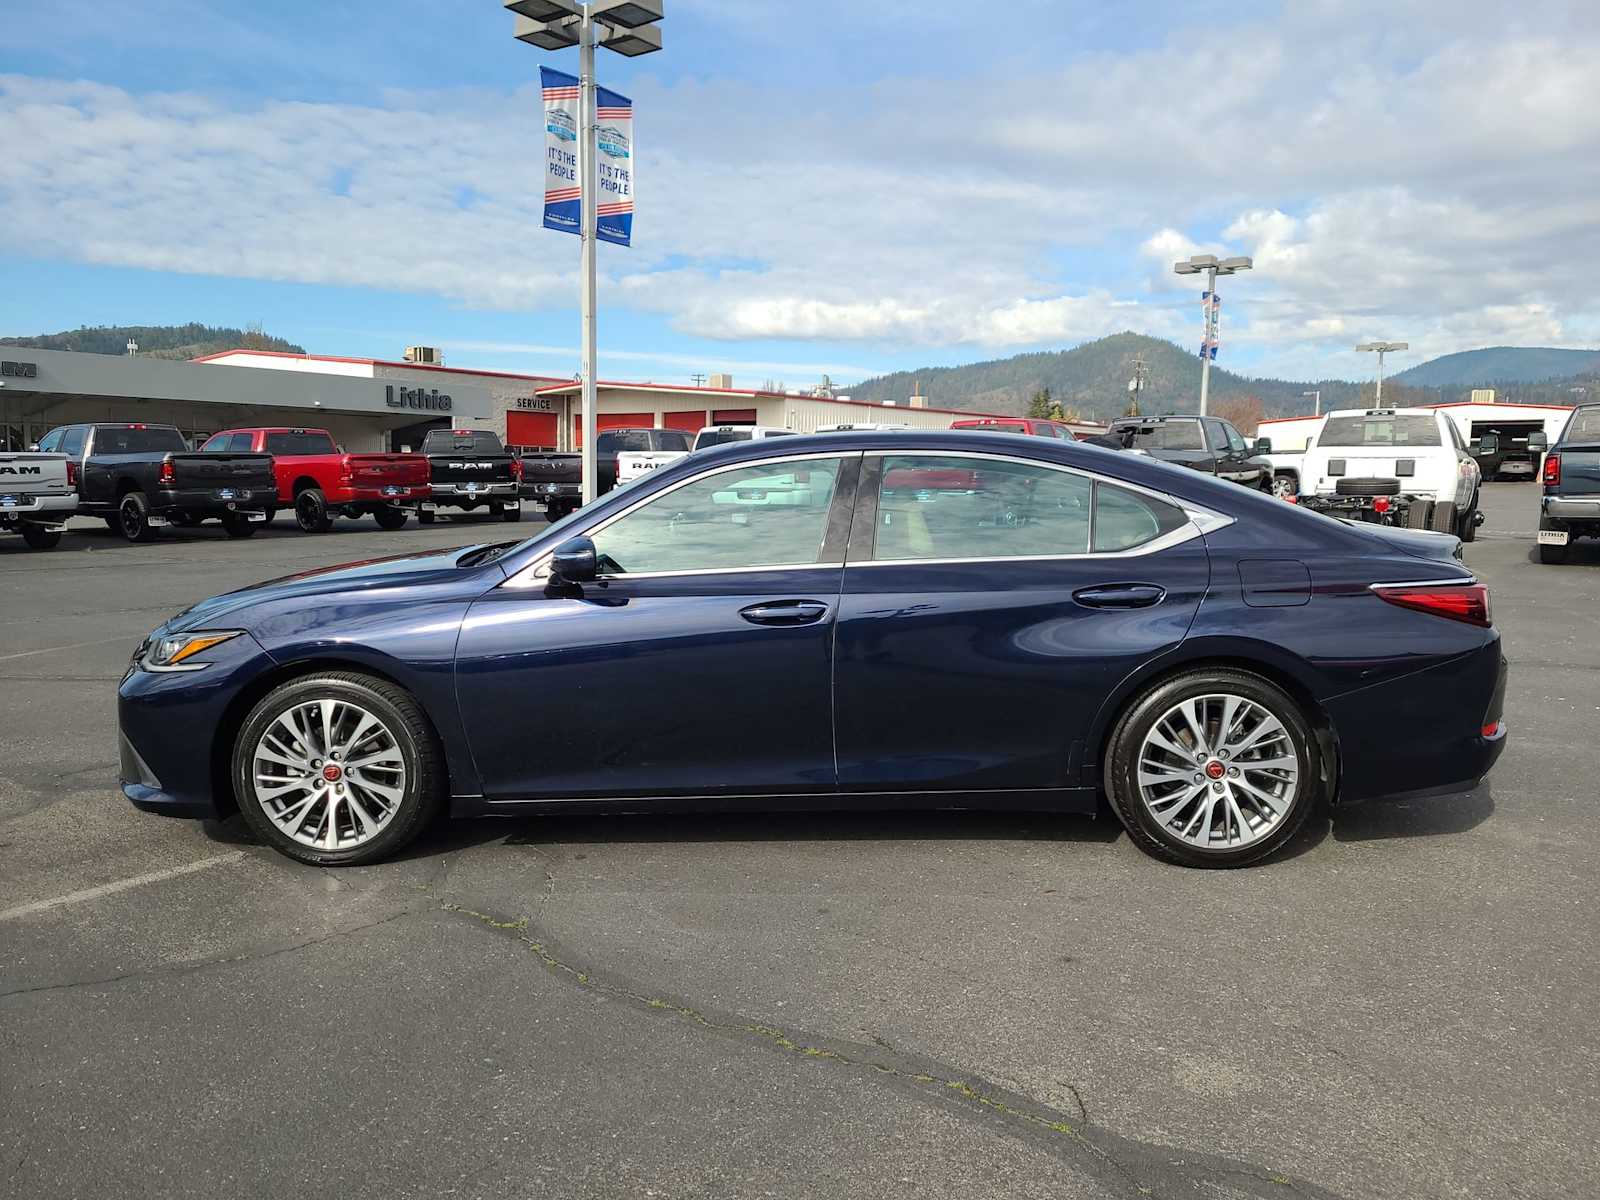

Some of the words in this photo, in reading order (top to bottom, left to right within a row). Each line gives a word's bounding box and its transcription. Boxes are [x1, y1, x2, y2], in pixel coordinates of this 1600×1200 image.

[548, 146, 562, 161] IT'S
[563, 151, 576, 166] THE
[550, 162, 576, 180] PEOPLE
[599, 162, 612, 177] IT'S
[614, 167, 630, 181] THE
[600, 178, 629, 195] PEOPLE
[385, 385, 452, 410] Lithia
[517, 398, 551, 409] SERVICE
